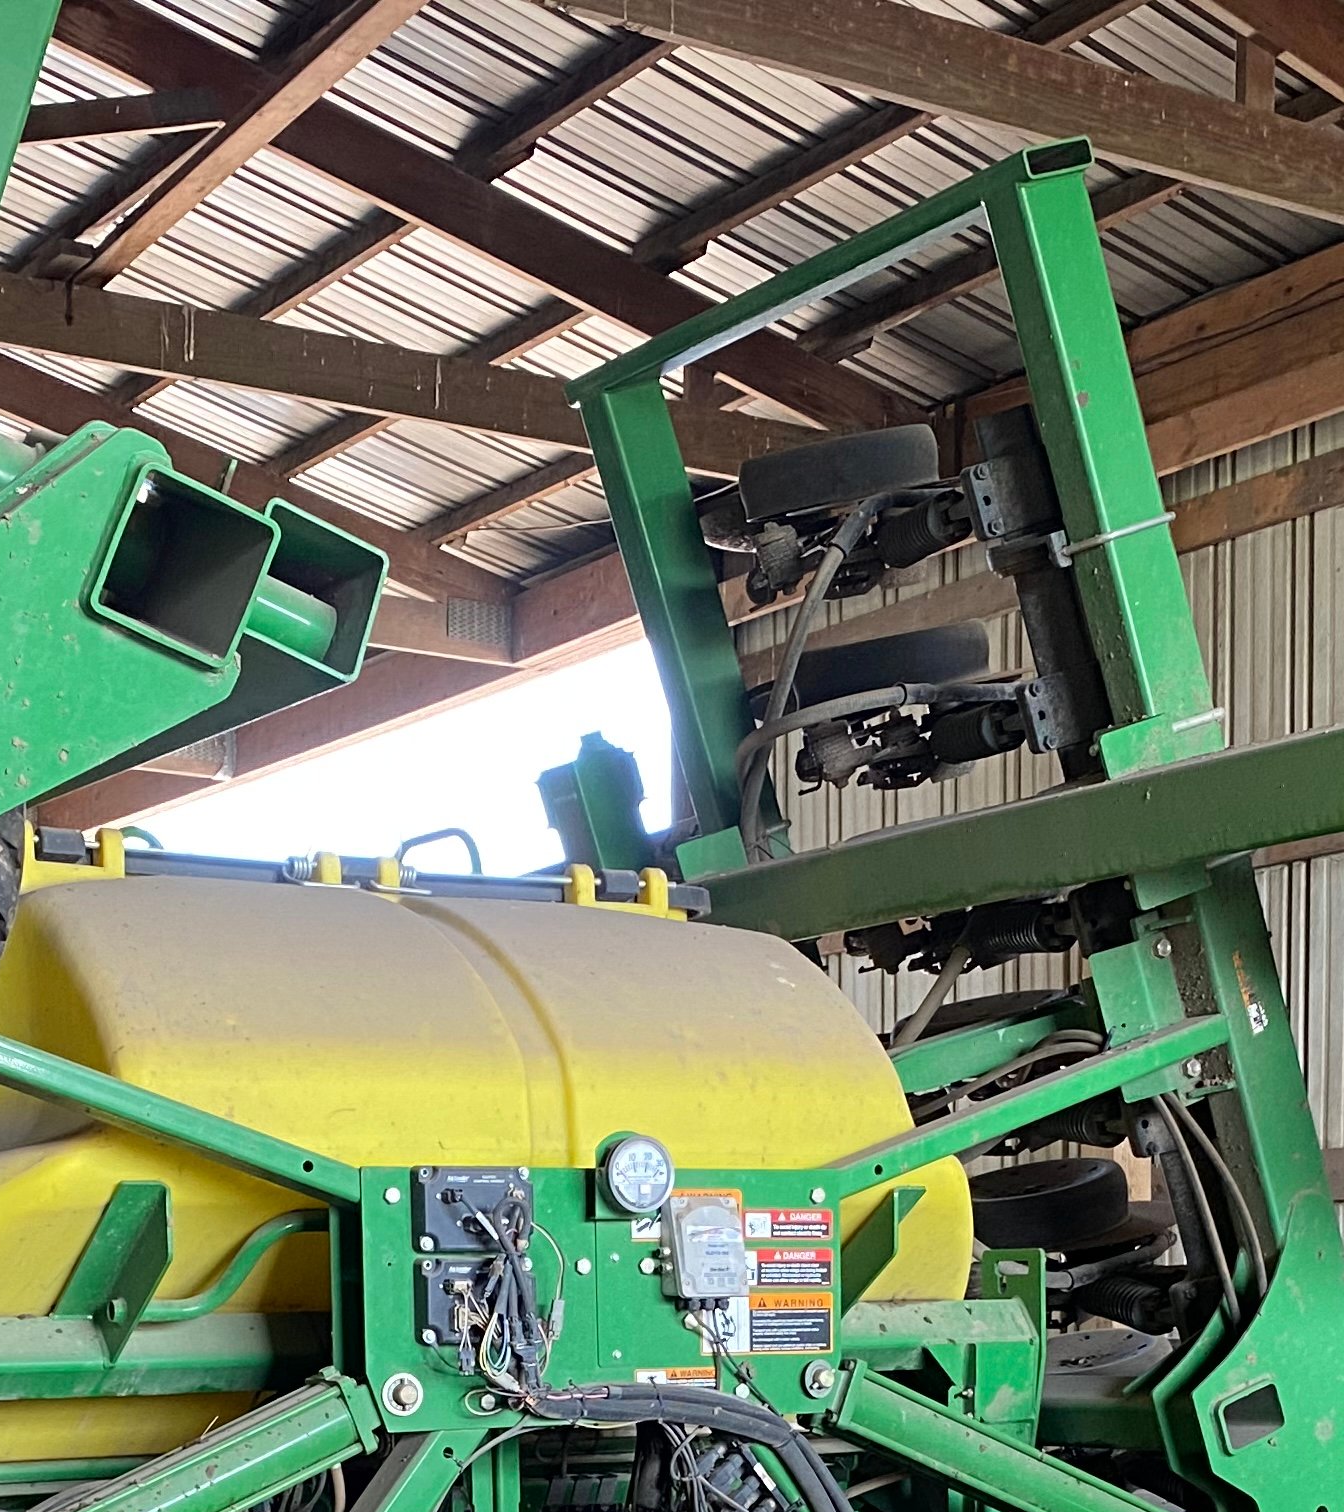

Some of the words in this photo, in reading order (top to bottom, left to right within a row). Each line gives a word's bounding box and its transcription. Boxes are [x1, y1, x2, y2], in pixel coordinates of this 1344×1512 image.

[789, 1213, 822, 1221] DANGER
[783, 1252, 816, 1260] DANGER
[774, 1298, 823, 1308] WARNING
